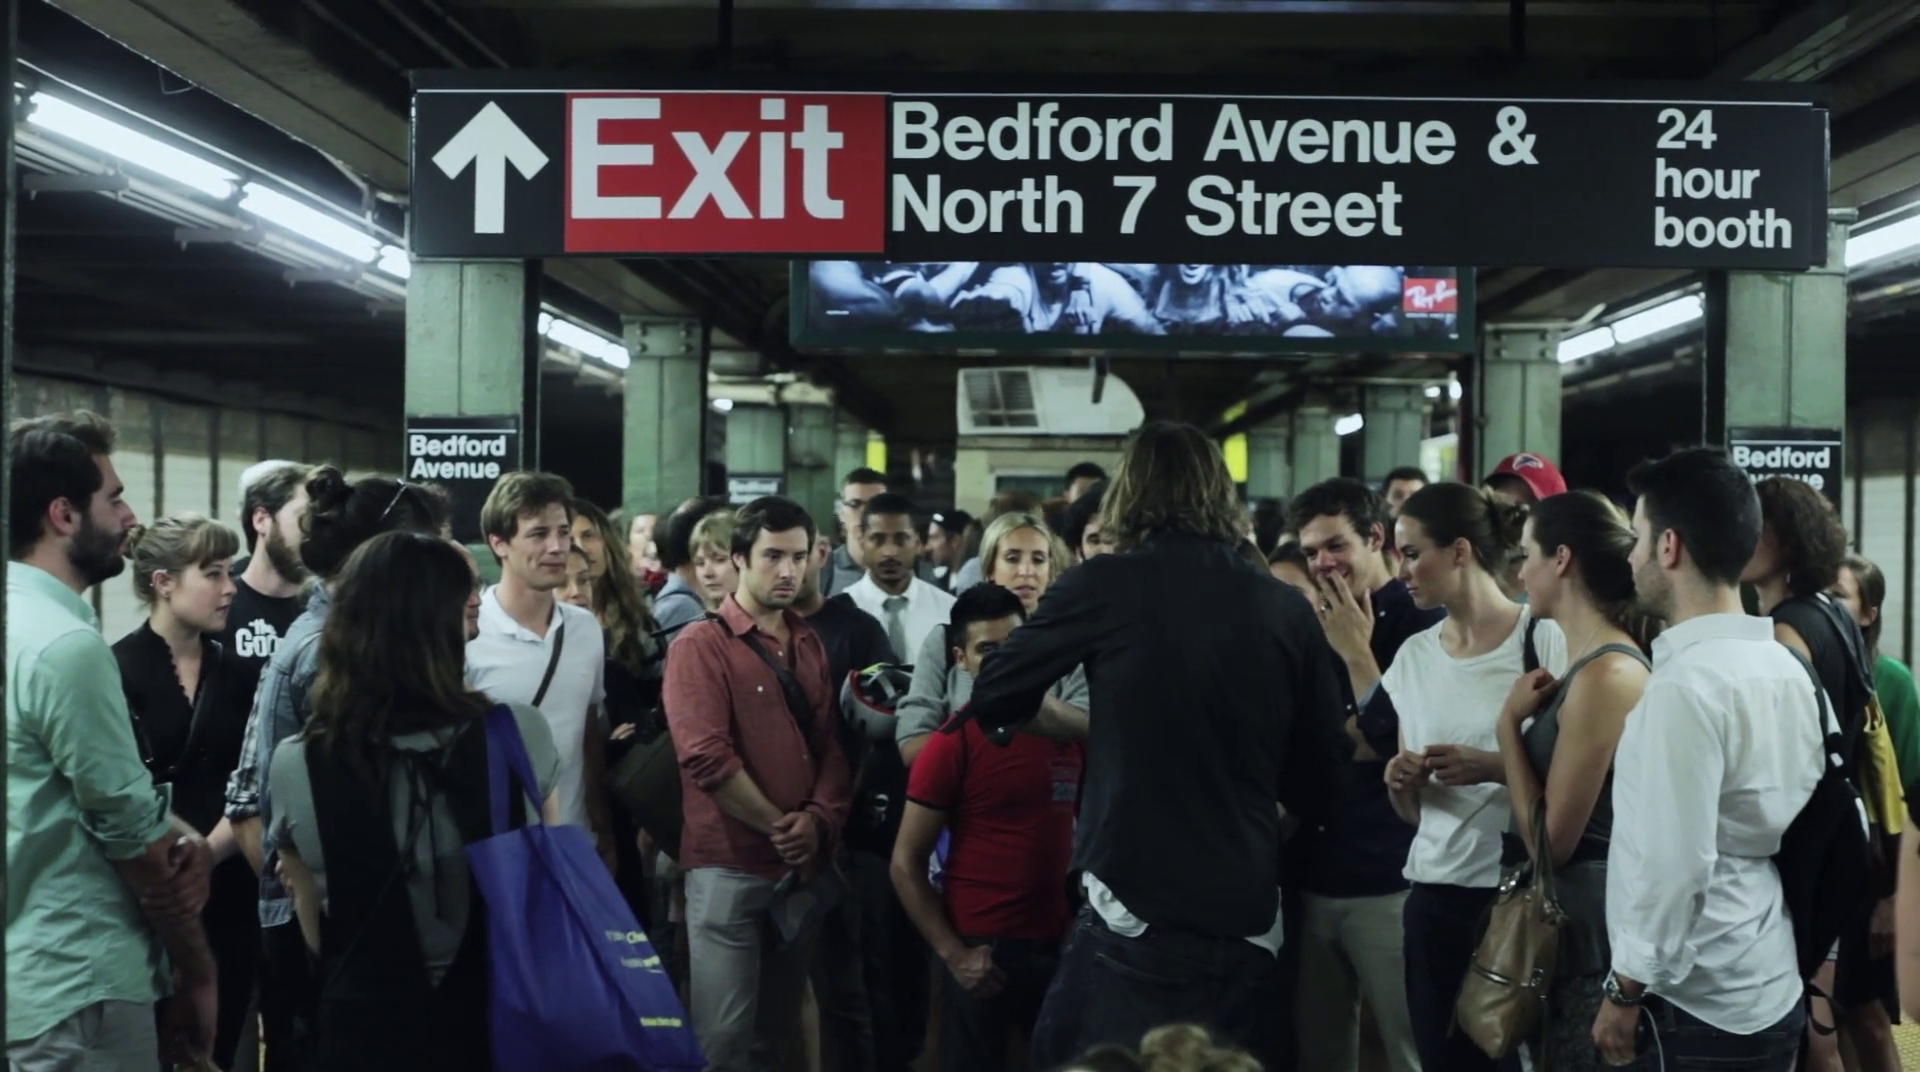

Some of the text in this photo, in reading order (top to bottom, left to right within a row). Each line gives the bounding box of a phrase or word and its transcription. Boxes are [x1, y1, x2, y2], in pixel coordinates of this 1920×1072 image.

[892, 101, 1540, 166] Bedford Avenue &
[1656, 107, 1718, 150] 24
[571, 97, 844, 219] Exit
[1655, 157, 1761, 200] hour
[892, 173, 1403, 237] North 7 Street
[1654, 206, 1793, 249] booth
[410, 434, 507, 457] Bedford
[1733, 446, 1830, 468] Bedford
[410, 457, 500, 479] Avenue
